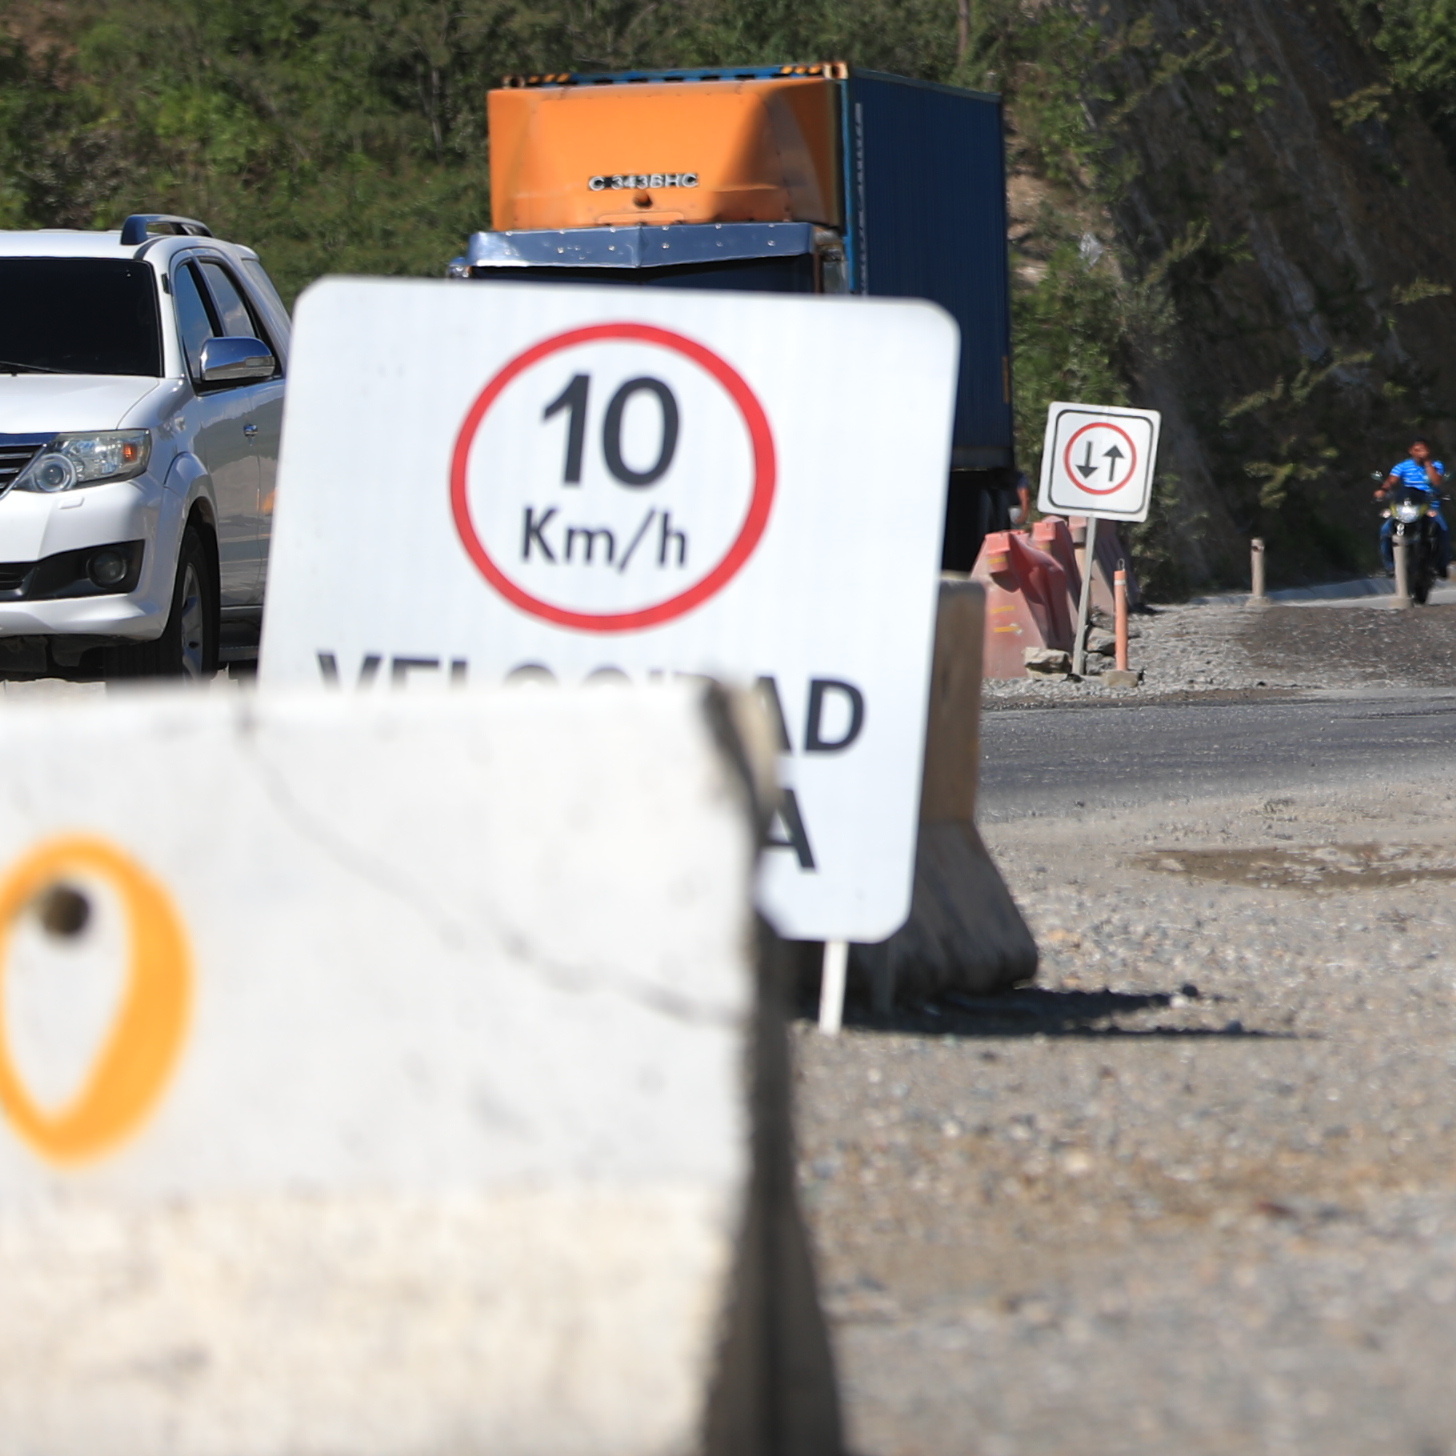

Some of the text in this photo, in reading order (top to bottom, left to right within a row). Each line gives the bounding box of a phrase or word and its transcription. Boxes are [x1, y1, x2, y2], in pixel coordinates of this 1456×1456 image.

[588, 175, 606, 191] C
[543, 373, 680, 488] 10
[522, 506, 687, 572] Km/h
